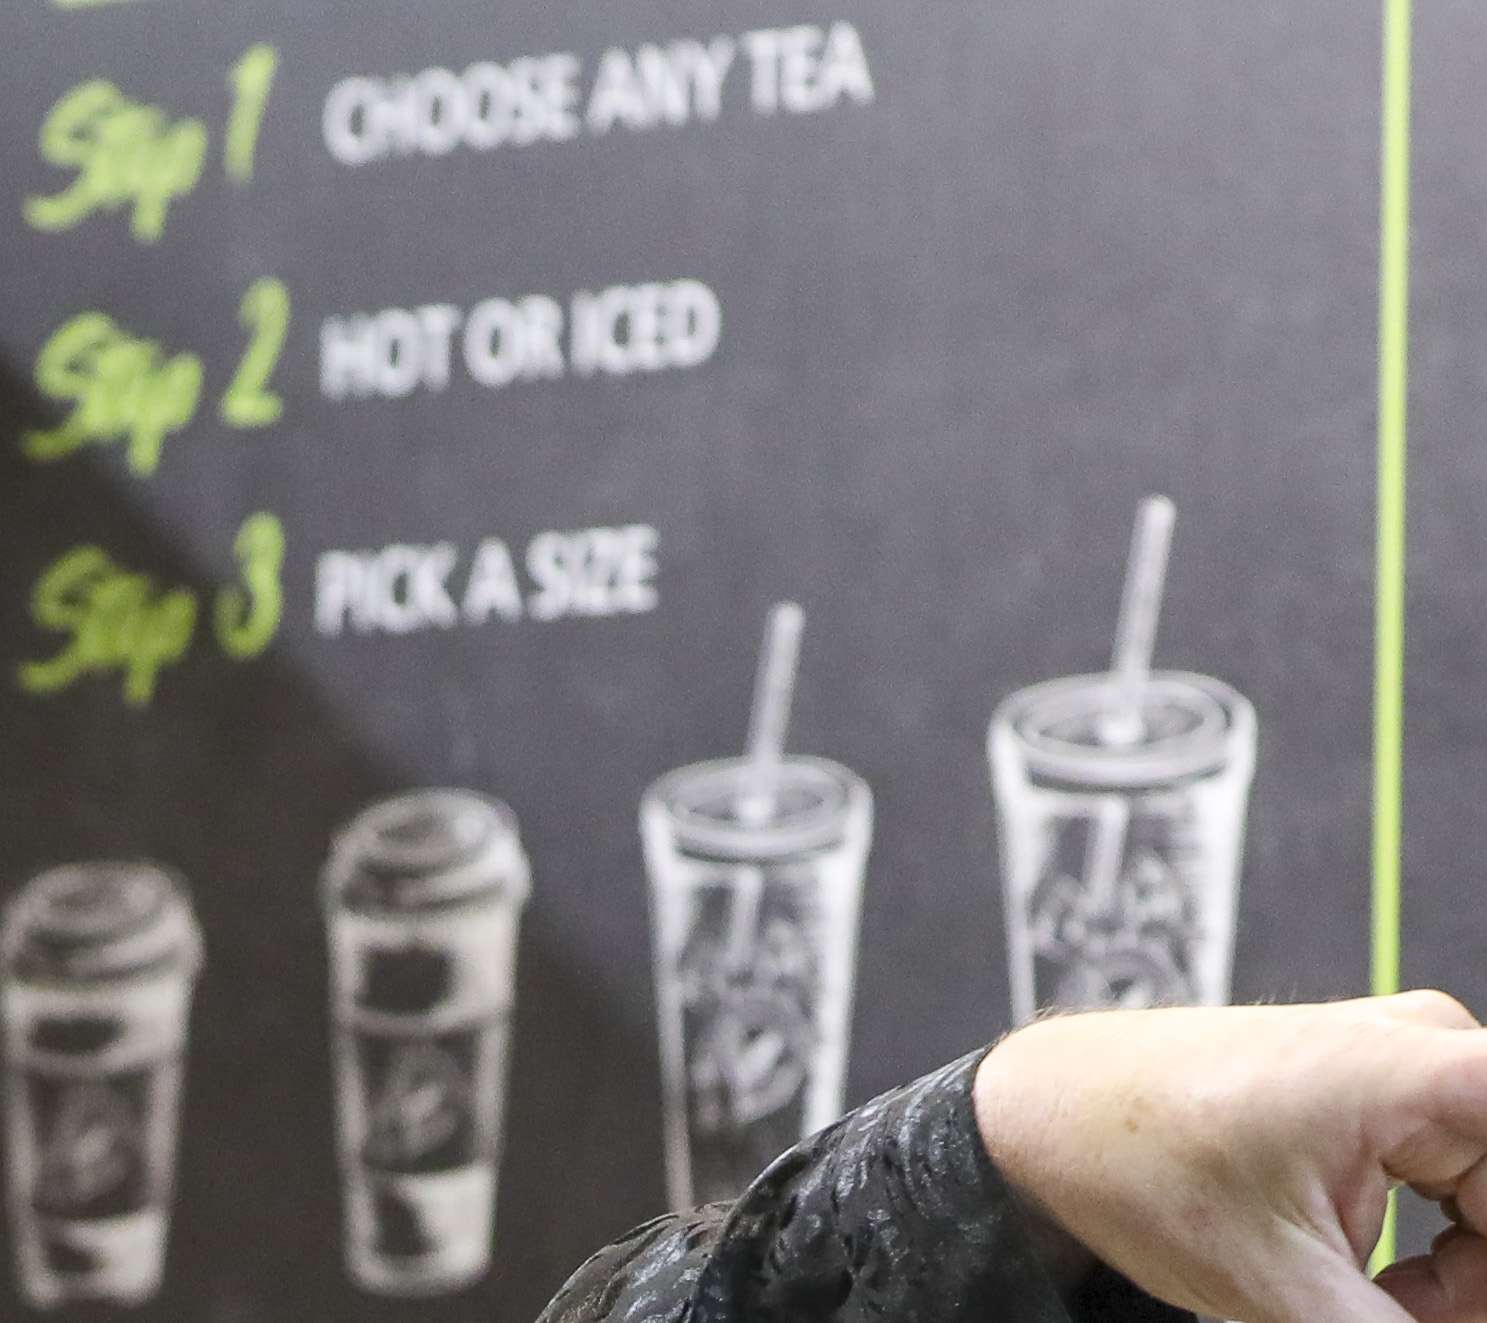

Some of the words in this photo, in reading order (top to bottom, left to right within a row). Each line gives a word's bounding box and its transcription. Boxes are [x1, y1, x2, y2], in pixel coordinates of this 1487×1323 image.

[23, 77, 207, 244] Step
[226, 41, 279, 186] 1
[323, 51, 581, 166] CHOOSE
[585, 35, 735, 135] ANY
[739, 20, 876, 117] TEA
[23, 311, 205, 477] Step
[222, 276, 291, 427] 2
[320, 303, 461, 400] HOT
[463, 295, 566, 387] OR
[569, 278, 723, 377] ICED
[20, 544, 198, 708] Step
[215, 511, 285, 662] 3
[313, 541, 459, 637] PICK
[460, 537, 524, 627] A
[525, 522, 660, 622] SIZE
